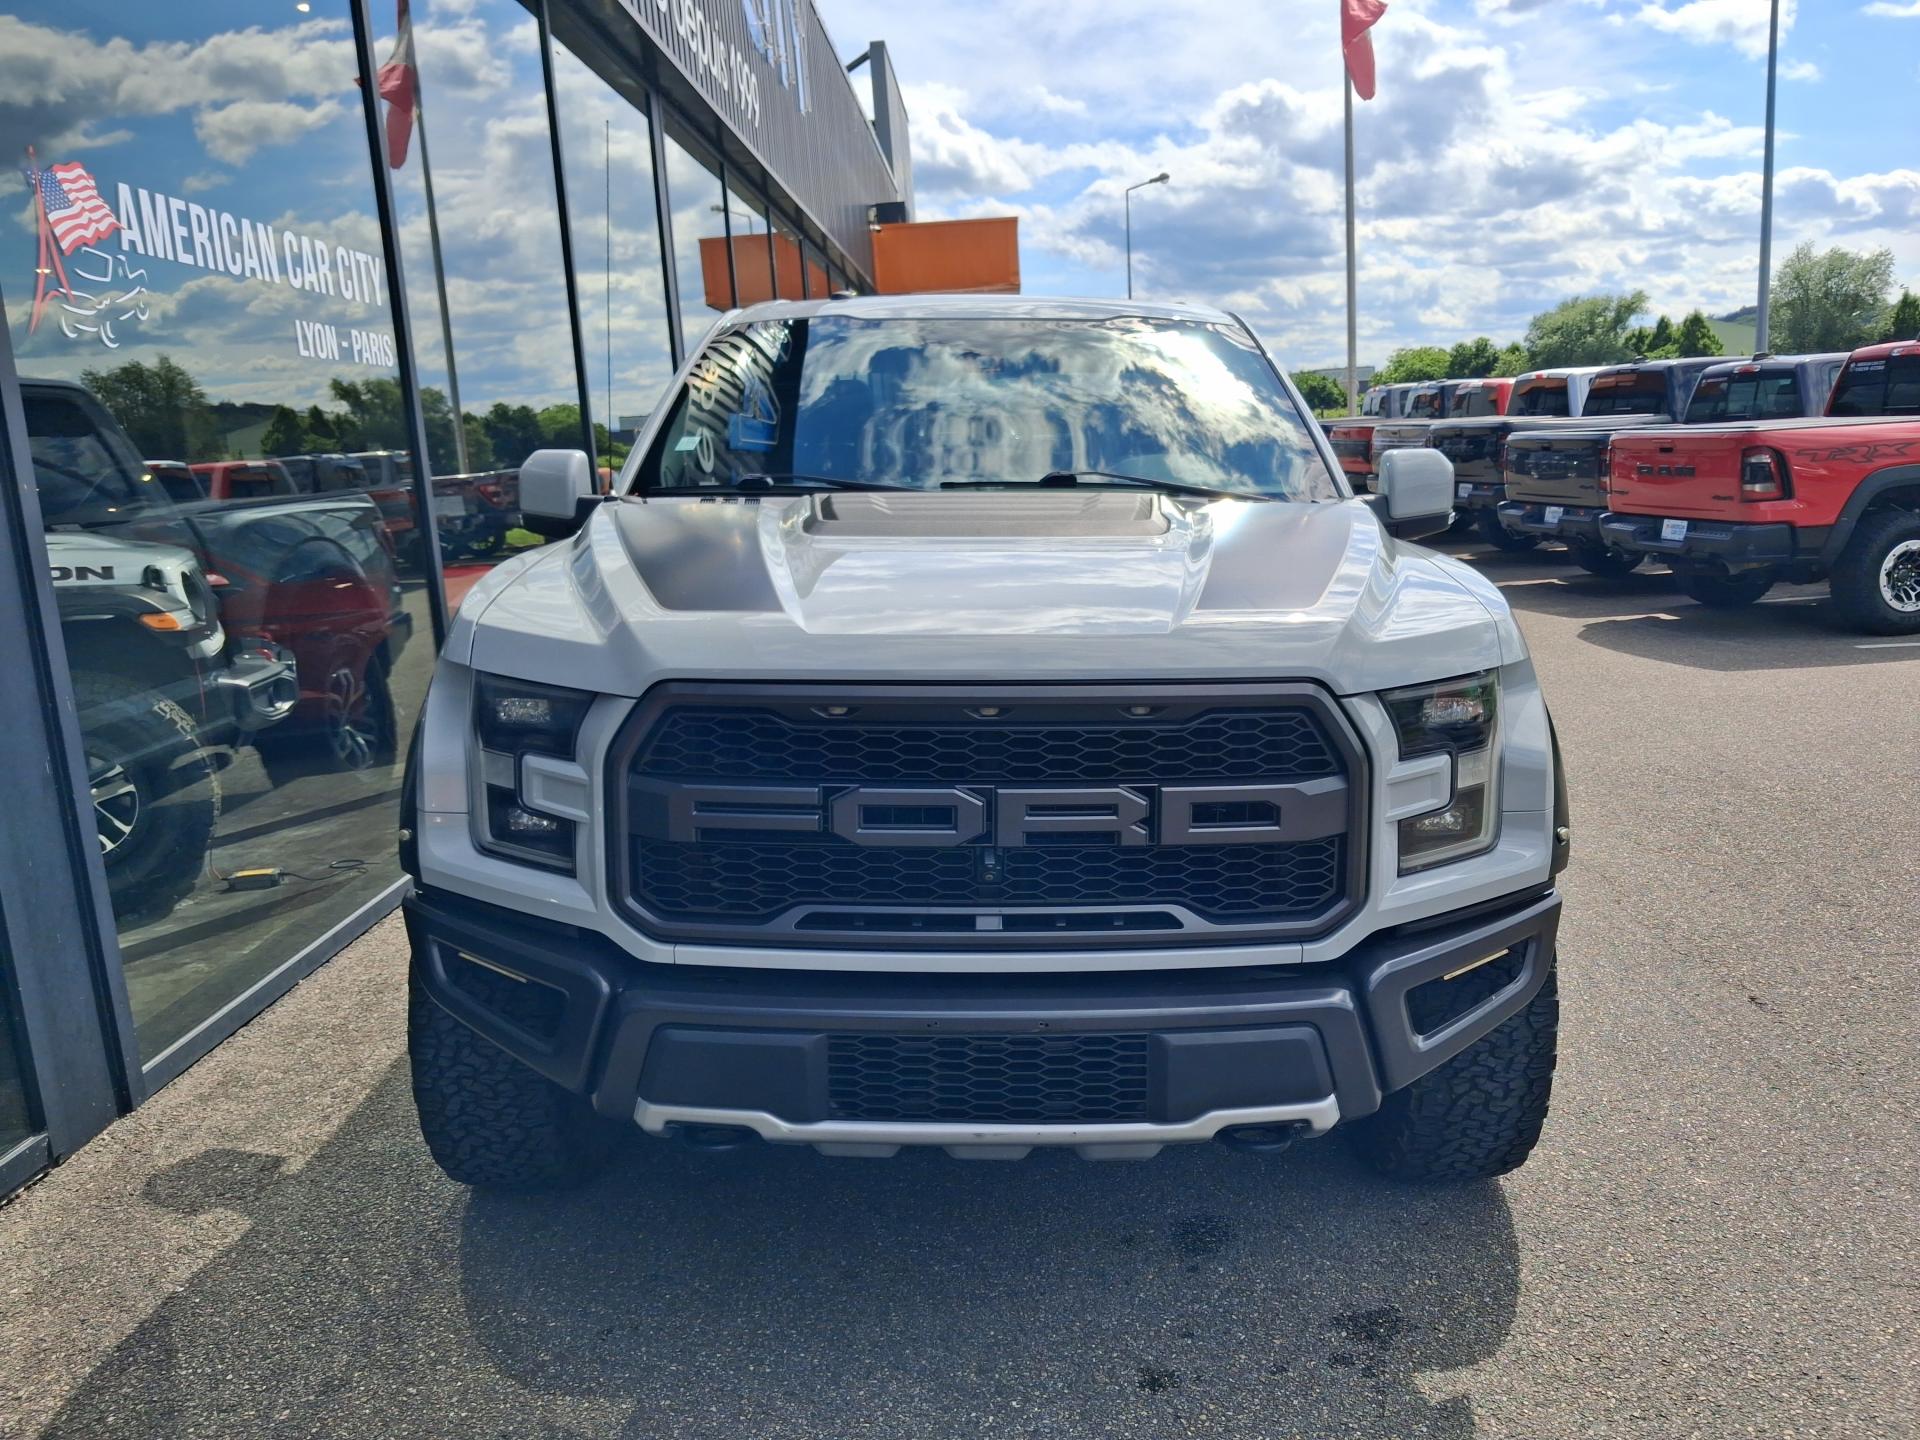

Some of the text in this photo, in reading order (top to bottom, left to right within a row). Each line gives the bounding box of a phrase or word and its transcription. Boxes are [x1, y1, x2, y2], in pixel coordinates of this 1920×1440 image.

[730, 44, 760, 128] 1999
[117, 182, 383, 306] AMERICAN CAR CITY
[295, 319, 339, 361] LYON
[351, 330, 394, 368] PARIS
[1636, 464, 1697, 478] RAM
[1796, 442, 1918, 464] TRX
[668, 783, 1347, 847] FORD
